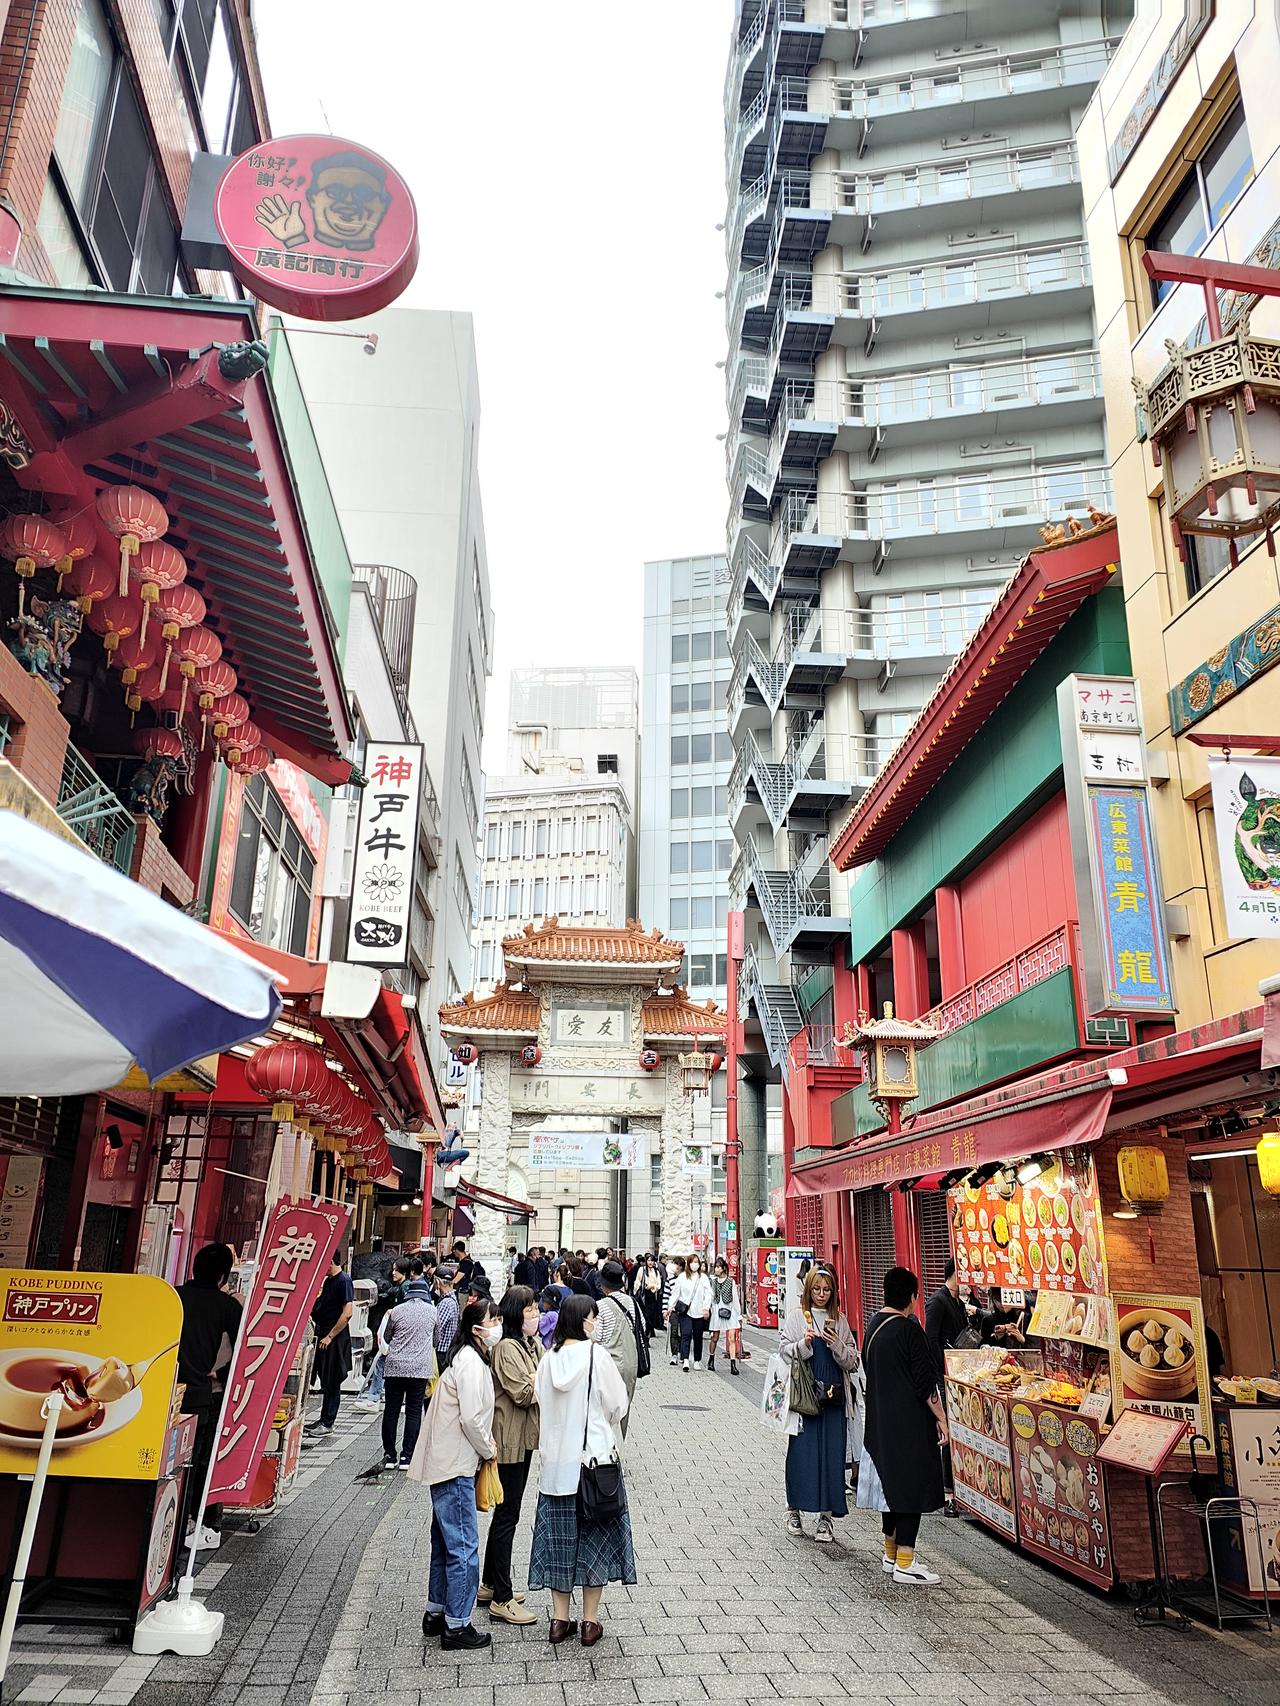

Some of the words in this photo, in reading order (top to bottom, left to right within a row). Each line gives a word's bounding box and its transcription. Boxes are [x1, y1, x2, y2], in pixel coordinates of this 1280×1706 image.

[256, 248, 364, 279] 廣記商行
[1078, 689, 1136, 705] マサニ
[1080, 709, 1136, 723] 南京町ビル
[1083, 733, 1095, 741] 5F
[363, 755, 413, 861] 神戸牛
[1108, 802, 1133, 872] 広東菜館
[383, 905, 404, 913] BEEF
[1239, 901, 1280, 913] 4月15
[1109, 880, 1157, 984] 青龍
[951, 1131, 977, 1164] 青龍
[9, 1277, 44, 1289] KOBE
[46, 1278, 103, 1290] PUDDING
[12, 1295, 93, 1317] 神戸プリン
[6, 1325, 91, 1337] 深いコクとなめらかな食感
[217, 1225, 318, 1462] 神戸プリン
[1086, 1463, 1107, 1569] おみやげ
